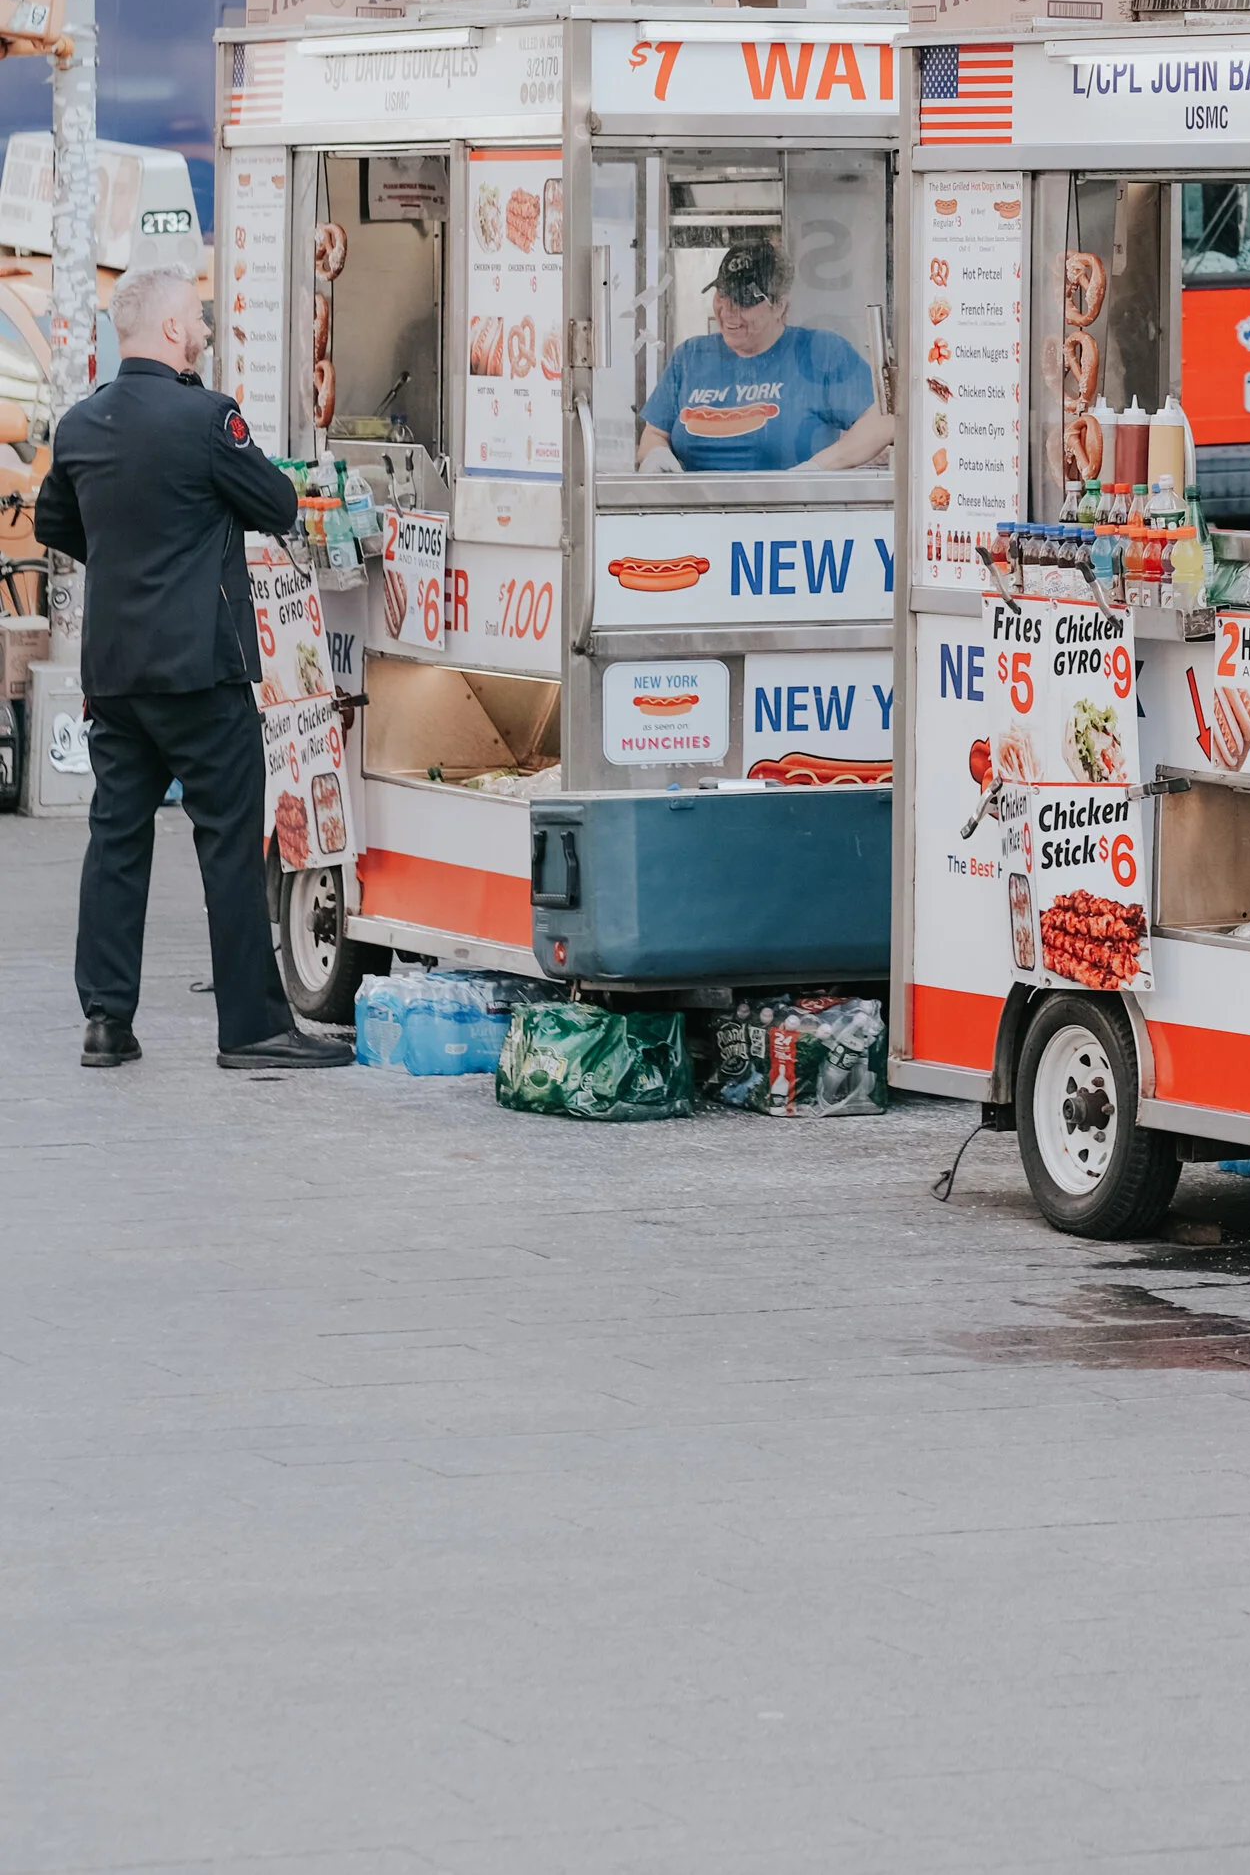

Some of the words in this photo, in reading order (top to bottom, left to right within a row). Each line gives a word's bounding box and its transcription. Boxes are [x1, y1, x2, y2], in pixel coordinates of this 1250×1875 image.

[354, 53, 398, 83] DAVID
[402, 48, 479, 81] GONZALES
[628, 41, 684, 101] $1
[1072, 63, 1143, 99] L/CPL
[1150, 60, 1218, 94] JOHN
[384, 91, 410, 111] USMC
[1185, 104, 1229, 130] USMC
[940, 182, 951, 191] Best
[952, 182, 969, 191] Grilled
[970, 182, 980, 191] Hot
[981, 181, 995, 193] Dogs
[1002, 181, 1015, 190] New
[142, 212, 190, 234] 2T32
[932, 218, 954, 230] Regular
[962, 267, 976, 279] Hot
[977, 267, 1003, 280] Pretzel
[961, 303, 985, 316] French
[986, 303, 1003, 316] Fries
[955, 346, 981, 359] Chicken
[982, 347, 1009, 363] Nuggets
[688, 386, 730, 404] NEW
[735, 382, 785, 403] YORK
[958, 385, 986, 398] Chicken
[987, 385, 1006, 399] Stick
[958, 422, 987, 436] Chicken
[988, 423, 1005, 440] Gyro
[958, 458, 984, 472] Potato
[985, 459, 1005, 472] Knish
[957, 493, 982, 507] Cheese
[982, 494, 1006, 509] Nachos
[385, 517, 399, 561] 2
[398, 521, 416, 550] HOT
[418, 525, 442, 557] DOGS
[398, 553, 413, 566] AND
[417, 557, 441, 571] WATER
[730, 538, 855, 596] NEW
[274, 570, 313, 600] Chicken
[279, 598, 304, 625] GYRO
[304, 593, 321, 637] $9
[417, 577, 440, 642] $6
[499, 578, 553, 641] $1.00
[993, 606, 1042, 644] Fries
[1055, 612, 1124, 645] Chicken
[1217, 621, 1240, 677] 2
[633, 676, 662, 690] NEW
[665, 675, 698, 688] YORK
[940, 643, 985, 702] NE
[997, 650, 1034, 714] $5
[1053, 648, 1101, 676] GYRO
[1103, 645, 1132, 699] $9
[297, 702, 333, 736] Chicken
[754, 685, 857, 733] NEW
[264, 714, 291, 746] Chicken
[622, 735, 711, 751] MUNCHIES
[642, 724, 652, 732] as
[654, 722, 674, 731] seen
[268, 744, 286, 776] Stick
[301, 735, 325, 766] w/Rice
[324, 726, 341, 768] $9
[1000, 790, 1028, 822] Chicken
[1038, 796, 1130, 833] Chicken
[1001, 827, 1021, 860] w/Rice
[947, 854, 967, 874] The
[970, 857, 995, 878] Best
[1040, 835, 1098, 870] Stick
[1098, 833, 1137, 888] $6
[774, 1031, 793, 1046] 24
